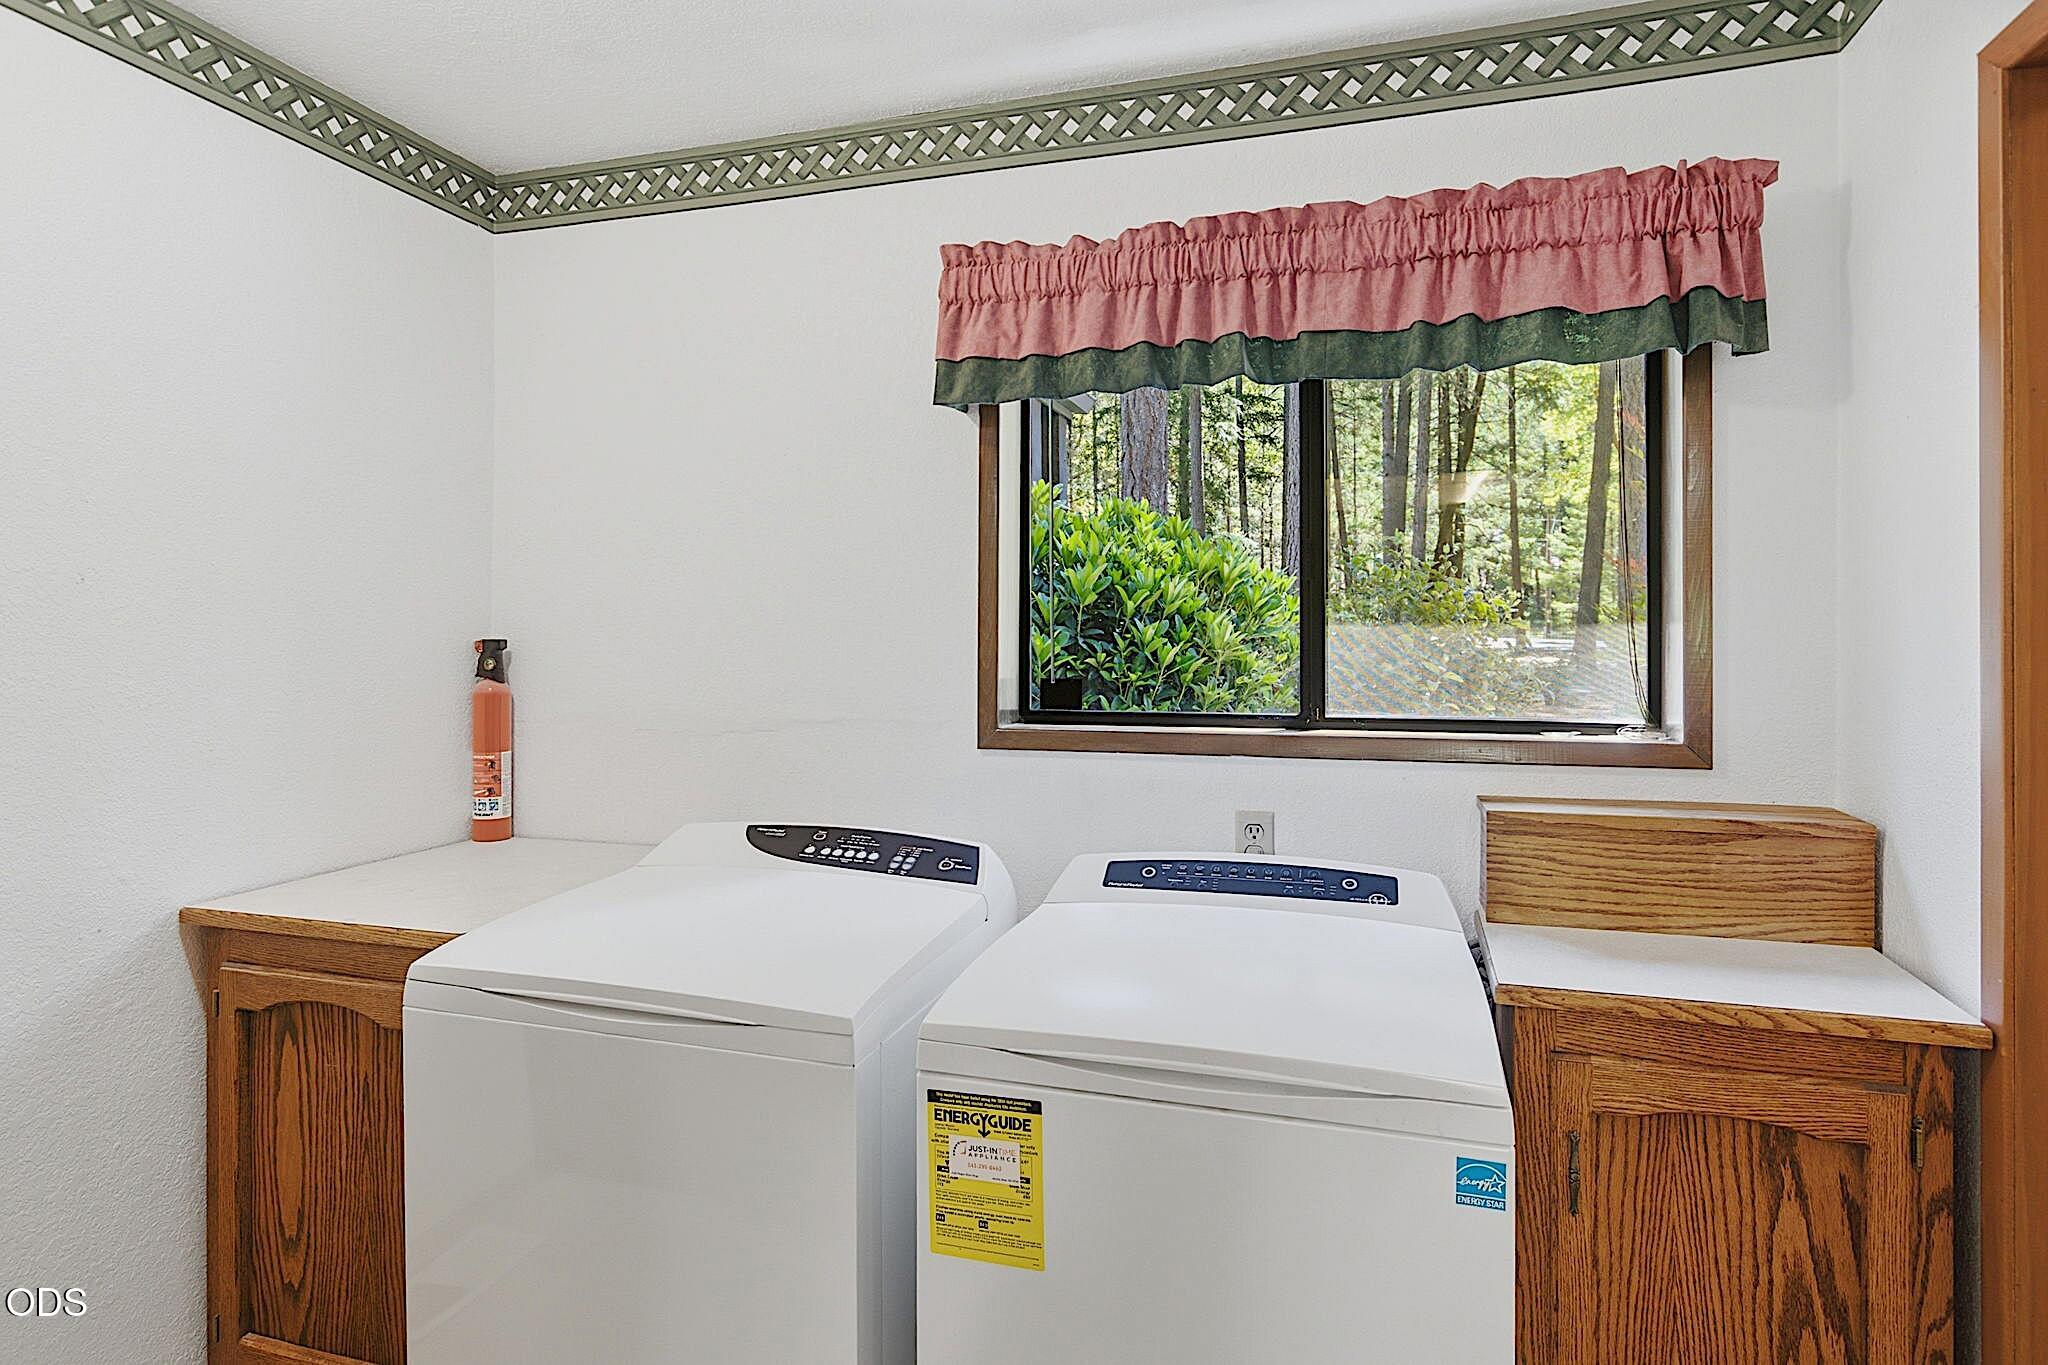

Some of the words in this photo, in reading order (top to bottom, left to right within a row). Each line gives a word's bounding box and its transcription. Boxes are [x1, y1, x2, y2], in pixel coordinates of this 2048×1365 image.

[934, 1108, 1032, 1133] ENERGYGUIDE
[968, 1153, 1017, 1163] APPLIANCE
[1457, 1195, 1485, 1206] ENERGY
[1486, 1200, 1505, 1209] STAR
